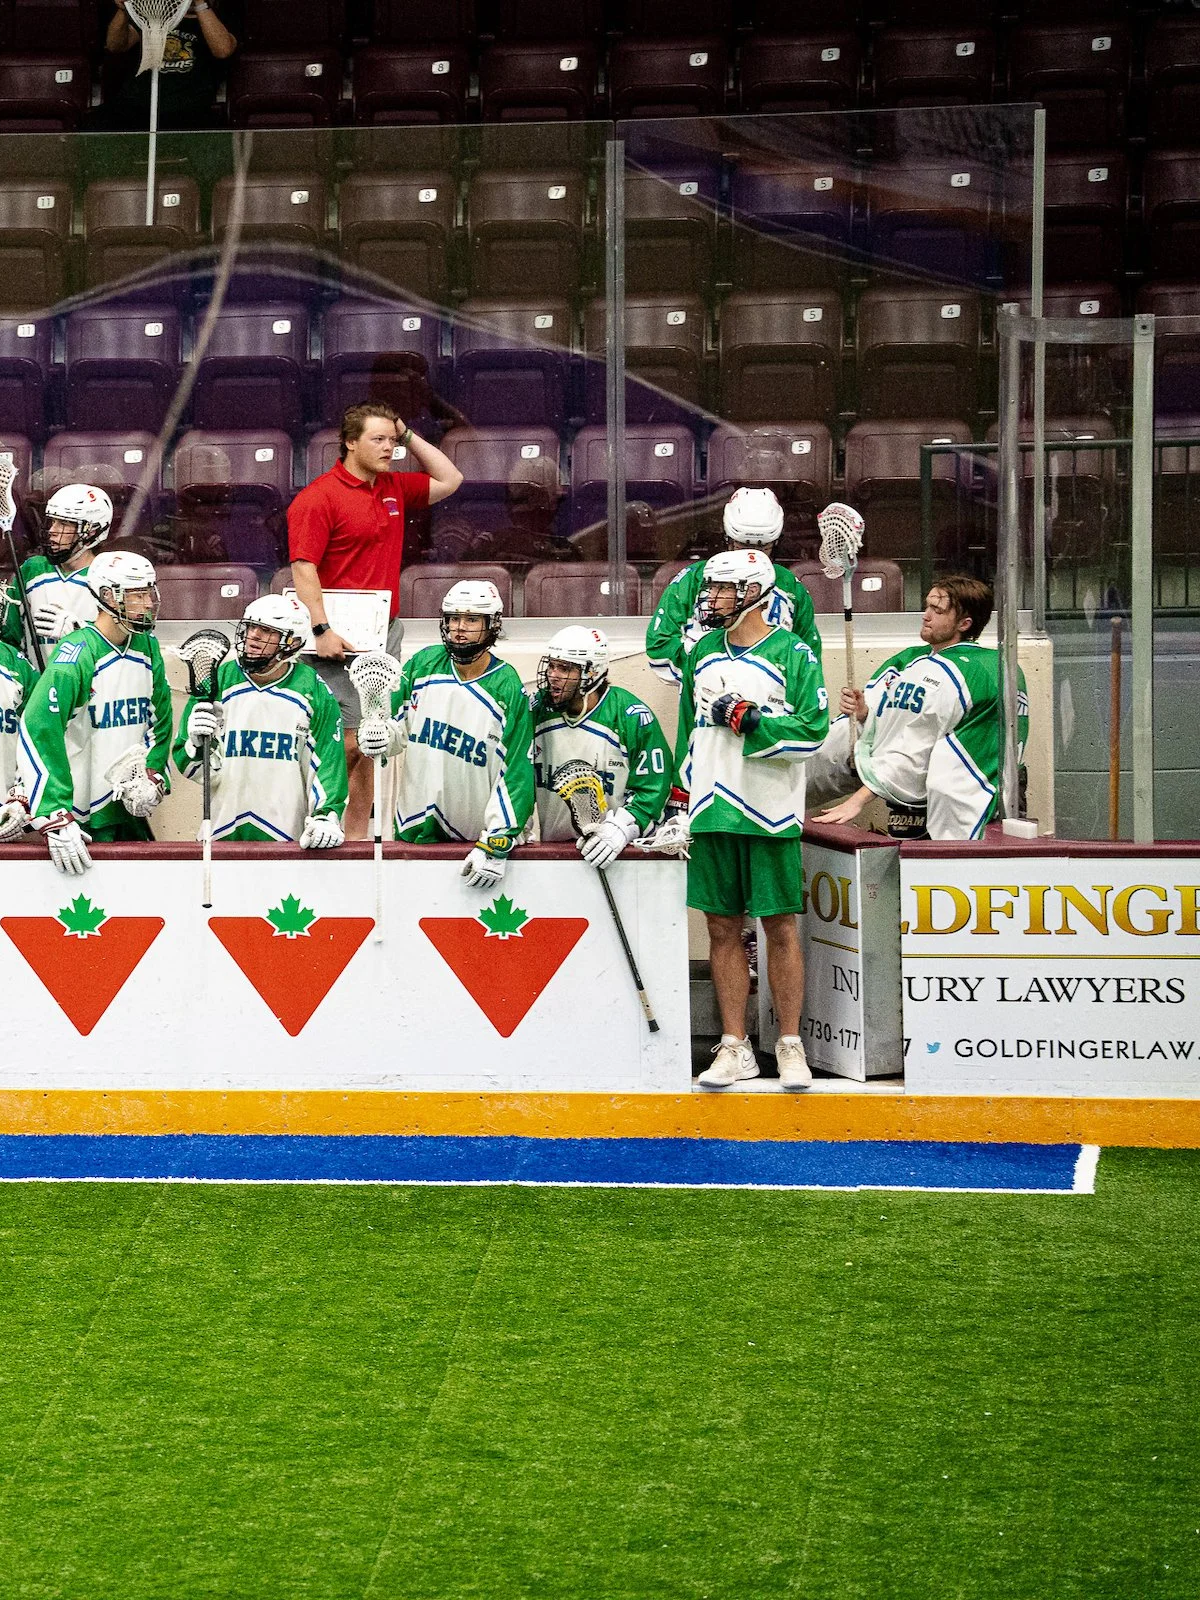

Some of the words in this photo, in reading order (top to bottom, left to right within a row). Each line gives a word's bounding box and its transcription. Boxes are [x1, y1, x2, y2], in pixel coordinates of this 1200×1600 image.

[635, 747, 666, 777] 20
[904, 976, 985, 1002] URY
[996, 977, 1186, 1004] LAWYERS
